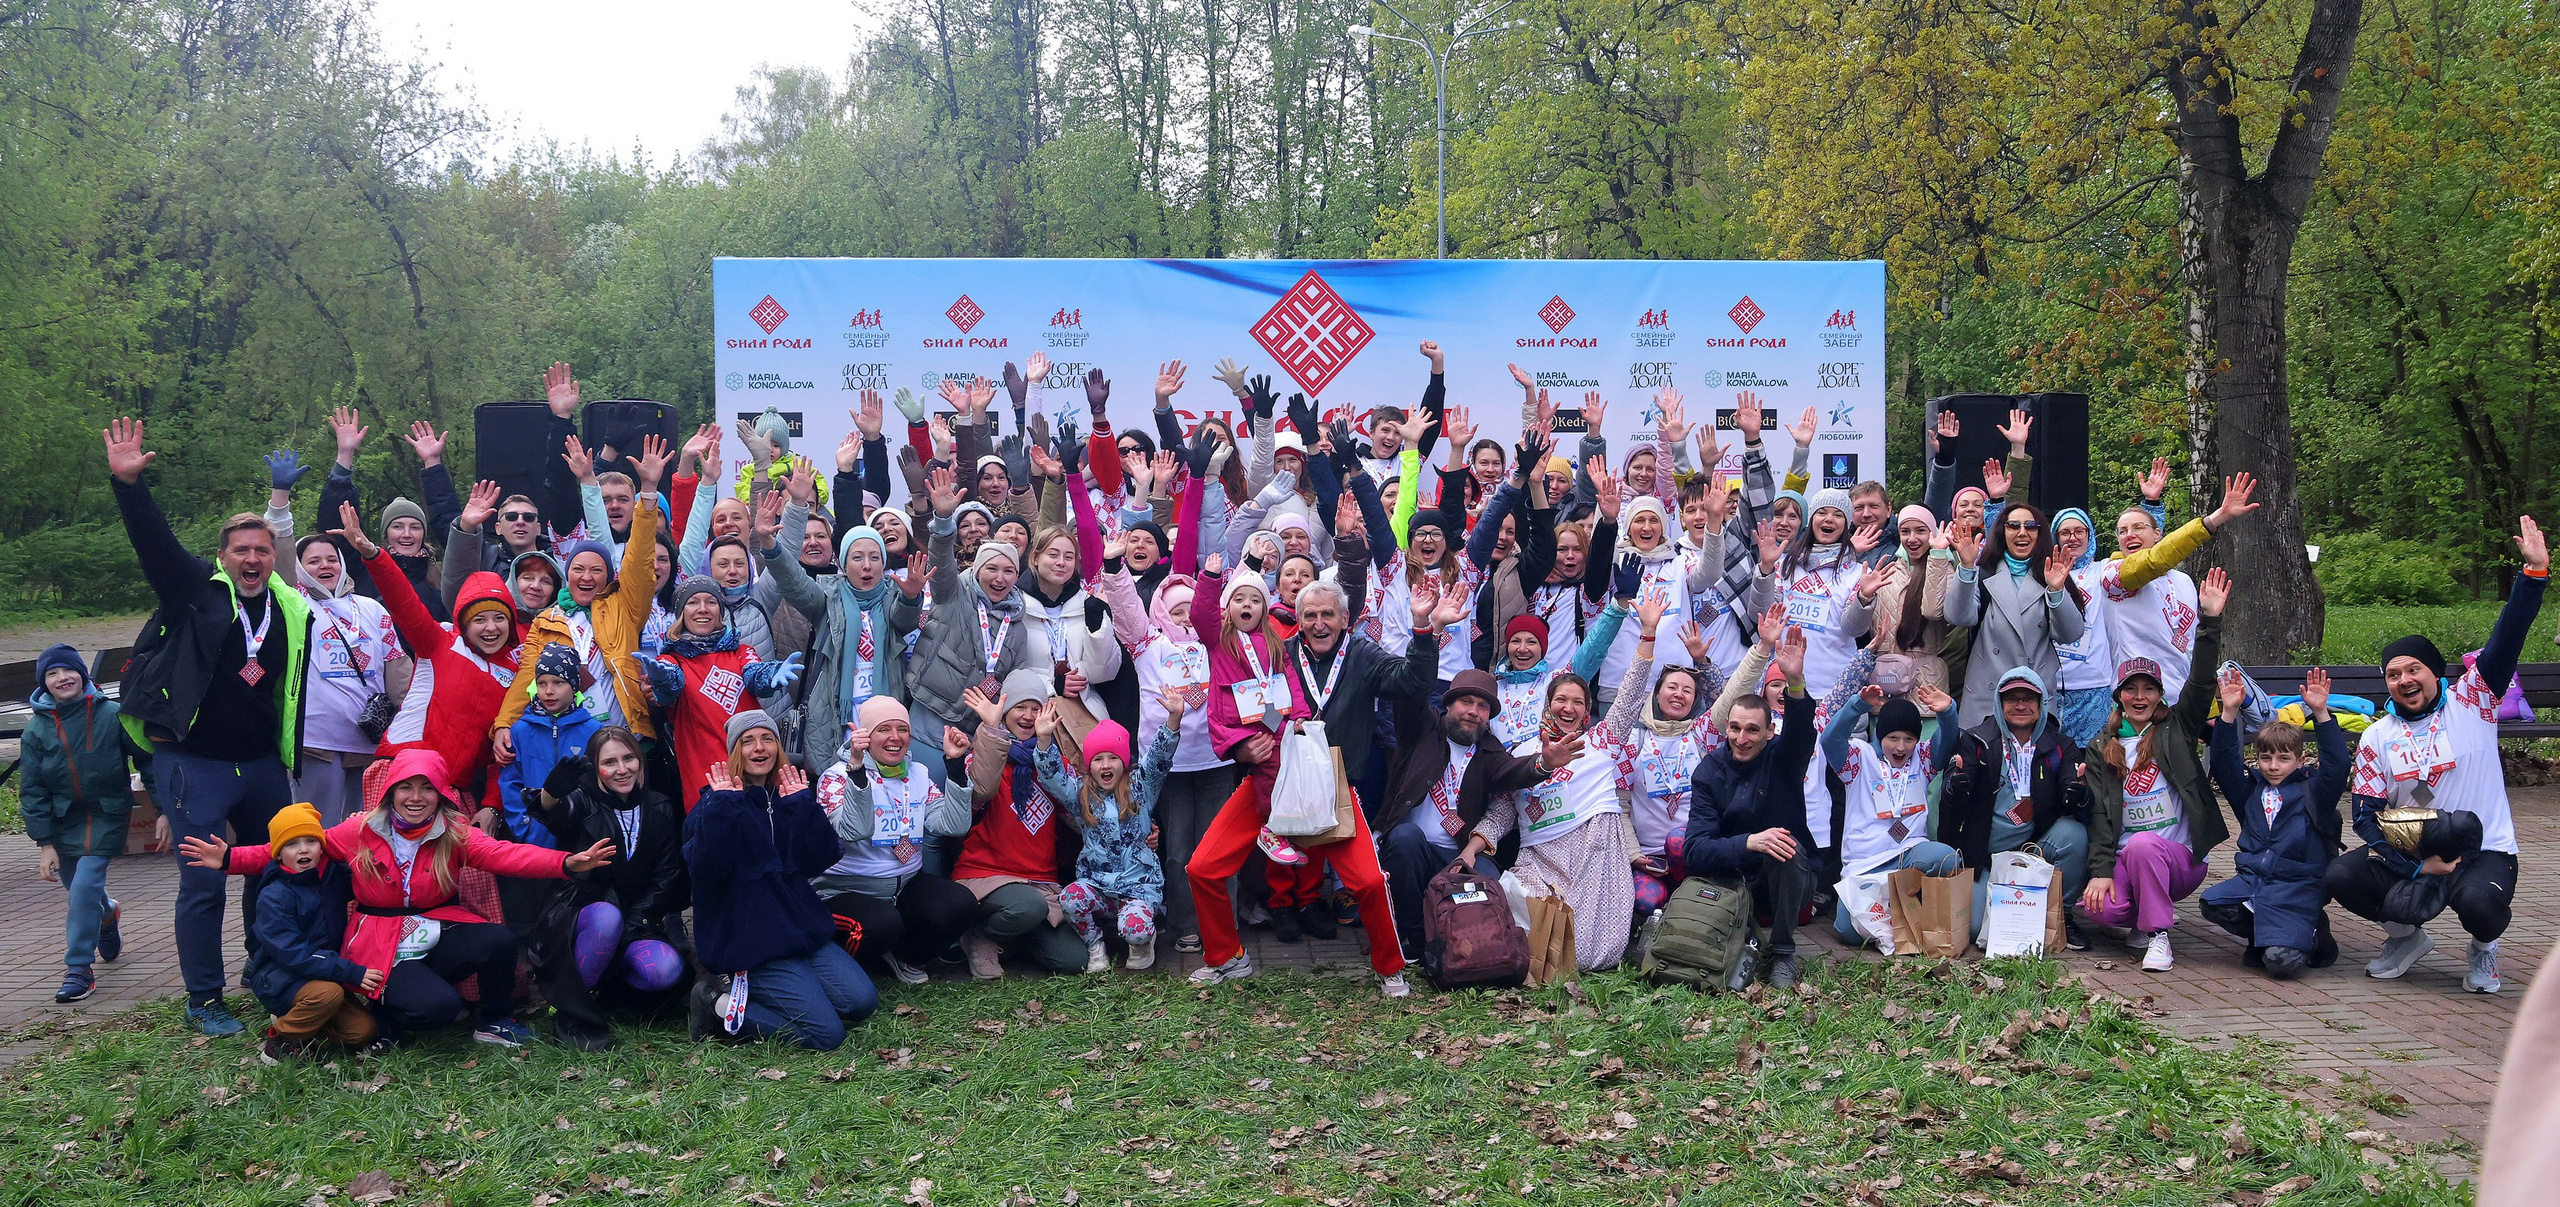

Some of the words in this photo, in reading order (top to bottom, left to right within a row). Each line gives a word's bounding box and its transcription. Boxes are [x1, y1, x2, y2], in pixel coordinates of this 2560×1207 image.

[727, 339, 767, 349] СИЛА
[773, 338, 812, 349] РОДА
[848, 339, 888, 348] ЗАБЕГ
[923, 338, 963, 348] СИЛА
[969, 338, 1008, 349] РОДА
[1048, 338, 1088, 347] ЗАБЕГ
[1516, 338, 1555, 347] СИЛА
[1560, 338, 1597, 348] РОДА
[1636, 338, 1674, 347] ЗАБЕГ
[1706, 338, 1745, 347] СИЛА
[1750, 338, 1786, 348] РОДА
[1823, 339, 1861, 347] ЗАБЕГ
[842, 363, 887, 377] МОРЕ
[1630, 362, 1673, 376] МОРЕ
[1818, 362, 1859, 376] МОРЕ
[748, 373, 781, 382] MARIA
[944, 372, 977, 381] MARIA
[1536, 372, 1568, 380] MARIA
[1726, 372, 1757, 380] MARIA
[748, 381, 815, 390] KONOVALOVA
[842, 376, 889, 391] ДОМА
[1536, 379, 1600, 388] KONOVALOVA
[1629, 375, 1674, 389] ДОМА
[1726, 379, 1789, 388] KONOVALOVA
[1817, 375, 1861, 389] ДОМА
[1630, 433, 1658, 442] ЛЮБО
[1818, 433, 1864, 442] ЛЮБОМИР
[1788, 602, 1820, 618] 2015
[329, 651, 348, 665] 20
[1876, 676, 1897, 684] PUMA
[2399, 744, 2440, 765] 101
[1540, 796, 1563, 813] 029
[2128, 802, 2165, 821] 5014
[881, 817, 916, 832] 204
[410, 928, 429, 944] 12
